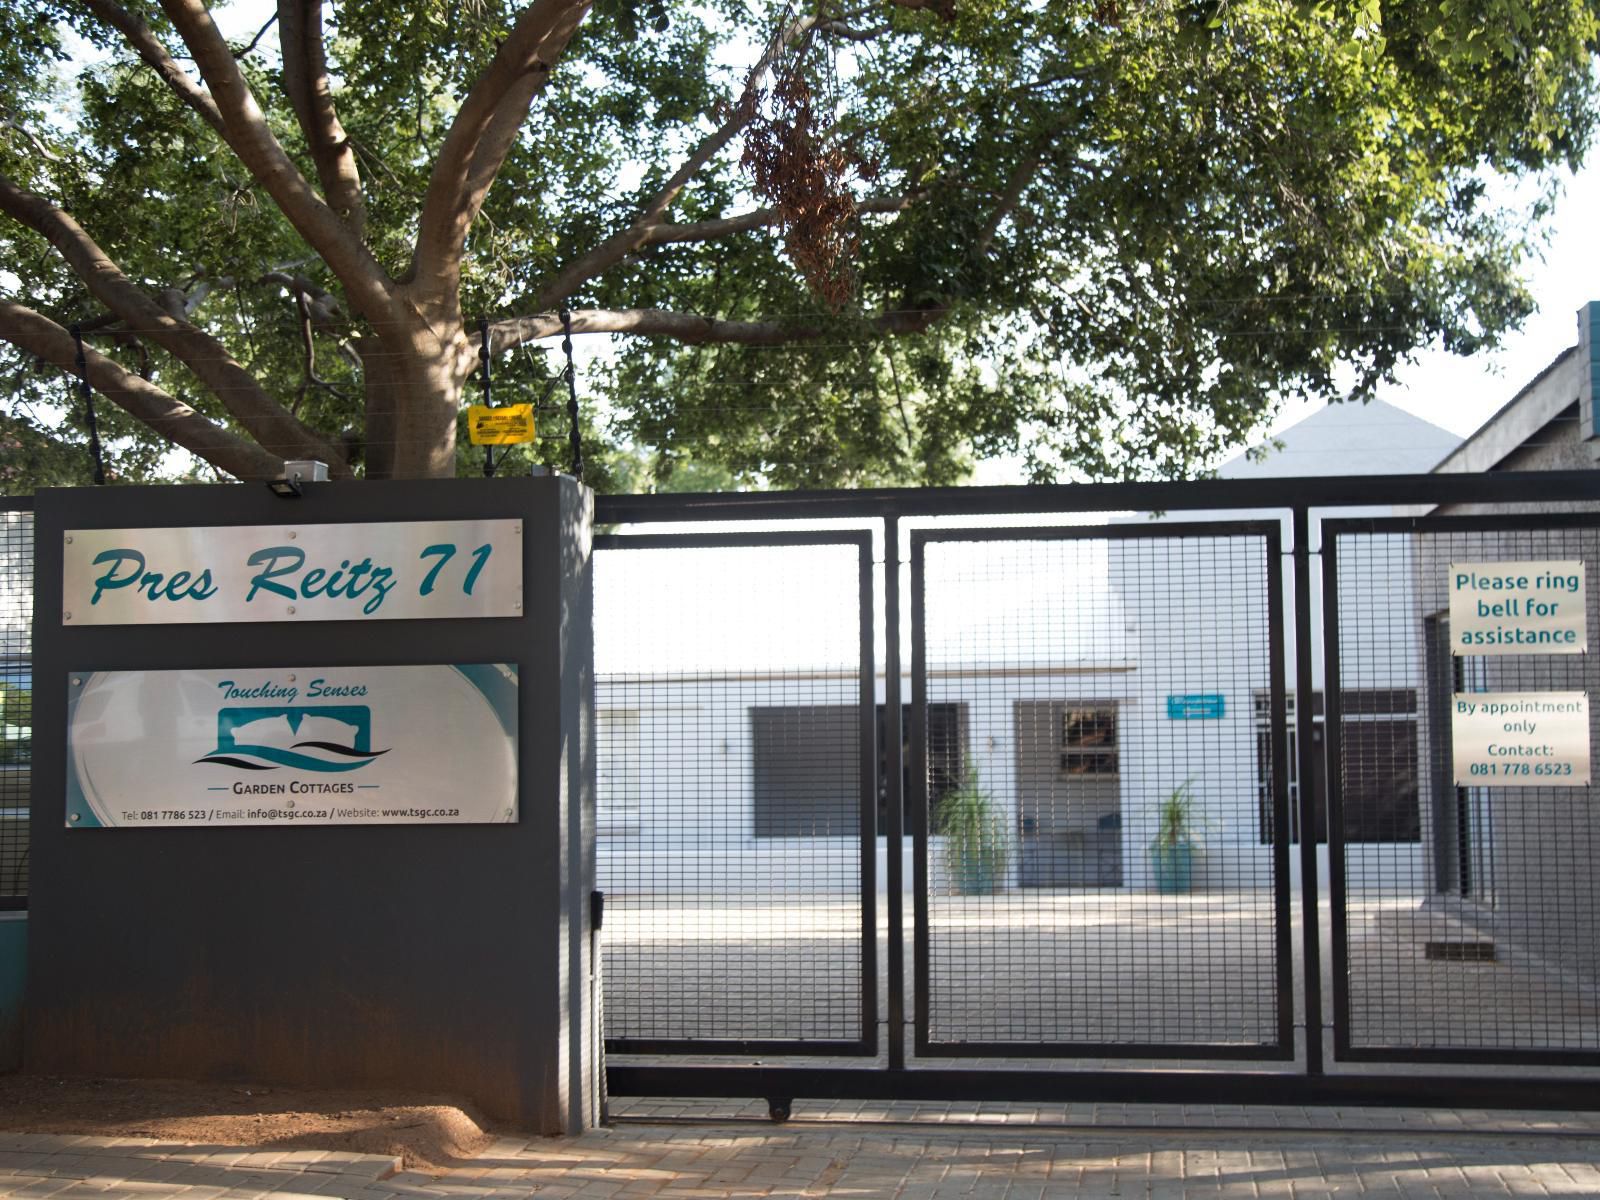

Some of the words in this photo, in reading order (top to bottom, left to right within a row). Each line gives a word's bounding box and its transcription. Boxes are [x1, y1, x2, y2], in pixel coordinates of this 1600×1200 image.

[92, 548, 218, 605] Pres
[246, 546, 396, 615] Reitz
[419, 543, 493, 596] 71
[1456, 574, 1529, 590] Please
[1536, 571, 1579, 592] ring
[1477, 599, 1519, 617] bell
[1526, 598, 1559, 616] for
[1461, 627, 1576, 644] assistance
[218, 680, 300, 704] Touching
[306, 679, 368, 698] Senses
[1457, 701, 1476, 715] By
[1481, 700, 1582, 716] appointment
[1503, 720, 1537, 733] only
[1488, 744, 1554, 756] Contact:
[1470, 764, 1497, 775] 081
[1502, 763, 1530, 775] 778
[1535, 763, 1572, 775] 6523
[121, 811, 138, 821] Tel:
[140, 811, 158, 820] 081
[161, 811, 186, 820] 7786
[188, 810, 206, 820] 523
[216, 810, 245, 820] Email:
[247, 809, 327, 820] info@tsgc.co.za
[337, 808, 380, 818] Website:
[382, 808, 460, 818] www.tsgc.co.za
